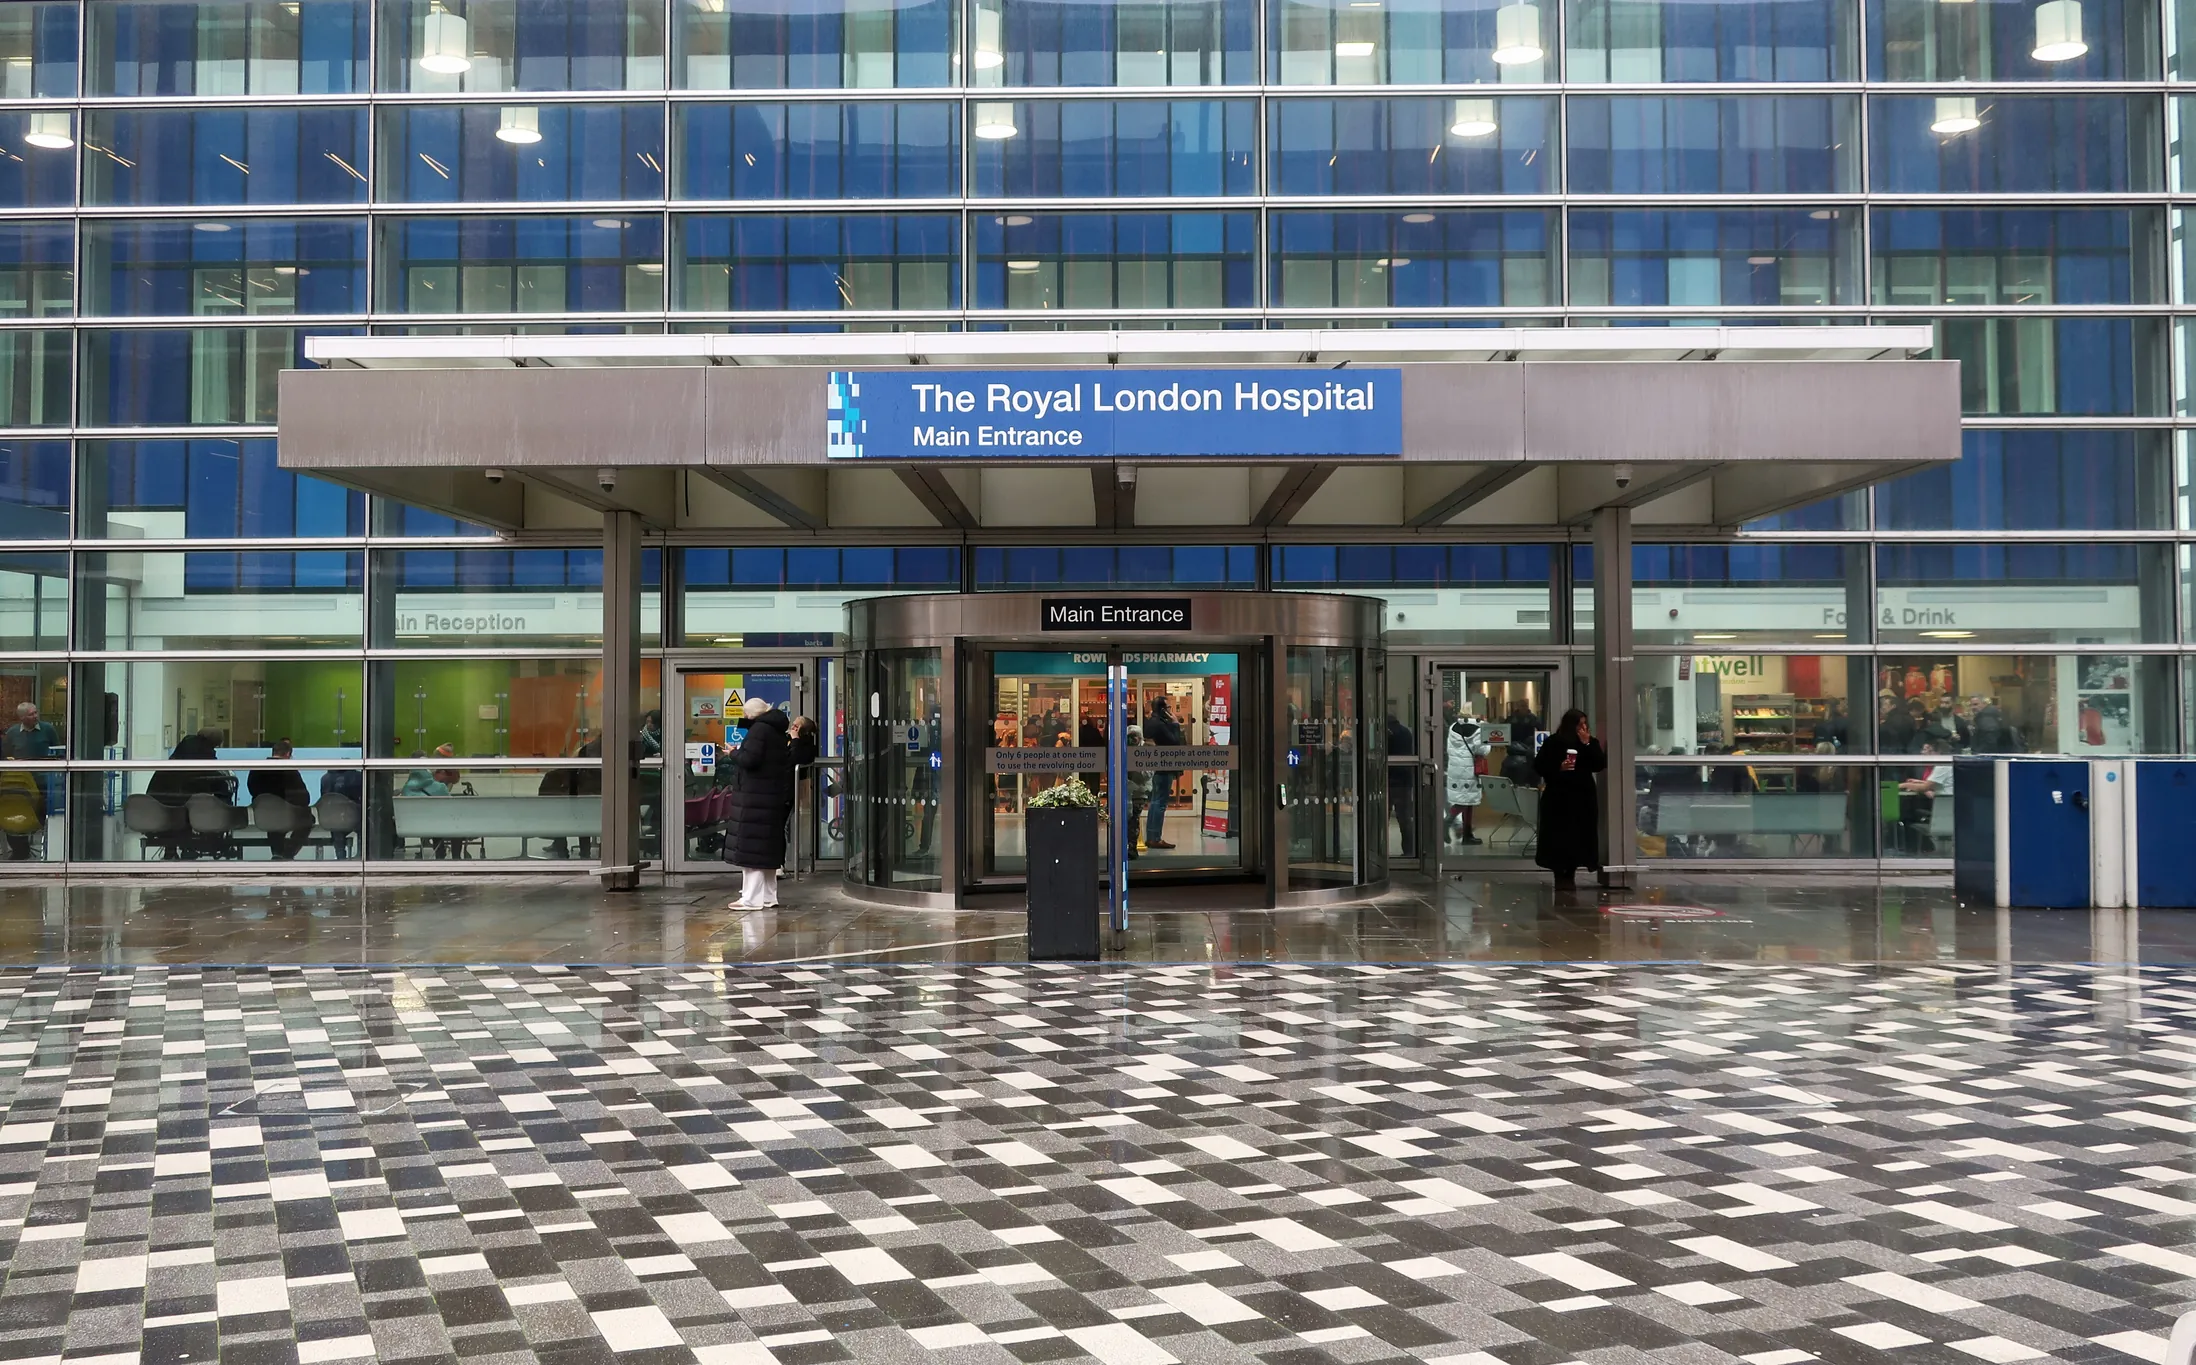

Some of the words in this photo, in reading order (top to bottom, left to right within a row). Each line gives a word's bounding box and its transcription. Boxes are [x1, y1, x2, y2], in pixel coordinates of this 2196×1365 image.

[911, 383, 975, 413] The
[986, 382, 1082, 420] Royal
[1092, 381, 1223, 413] London
[1234, 380, 1375, 417] Hospital
[912, 427, 970, 448] Main
[978, 425, 1083, 447] Entrance
[1050, 605, 1095, 623] Main
[1100, 605, 1185, 623] Entrance
[1881, 607, 1896, 625] &
[1902, 607, 1957, 625] Drink
[425, 613, 527, 634] Reception
[1143, 652, 1210, 663] PHARMACY
[996, 751, 1014, 760] Only
[1016, 751, 1022, 759] 6
[1023, 751, 1050, 760] people
[1052, 751, 1061, 759] at
[1133, 749, 1152, 759] Only
[1153, 749, 1159, 757] 6
[1160, 749, 1188, 759] people
[1213, 749, 1230, 757] time
[1023, 761, 1037, 769] the
[1038, 761, 1075, 770] revolving
[1076, 761, 1096, 769] door
[1135, 760, 1144, 768] to
[1145, 760, 1159, 768] use
[1160, 759, 1174, 768] the
[1175, 759, 1211, 769] revolving
[1212, 758, 1229, 767] door
